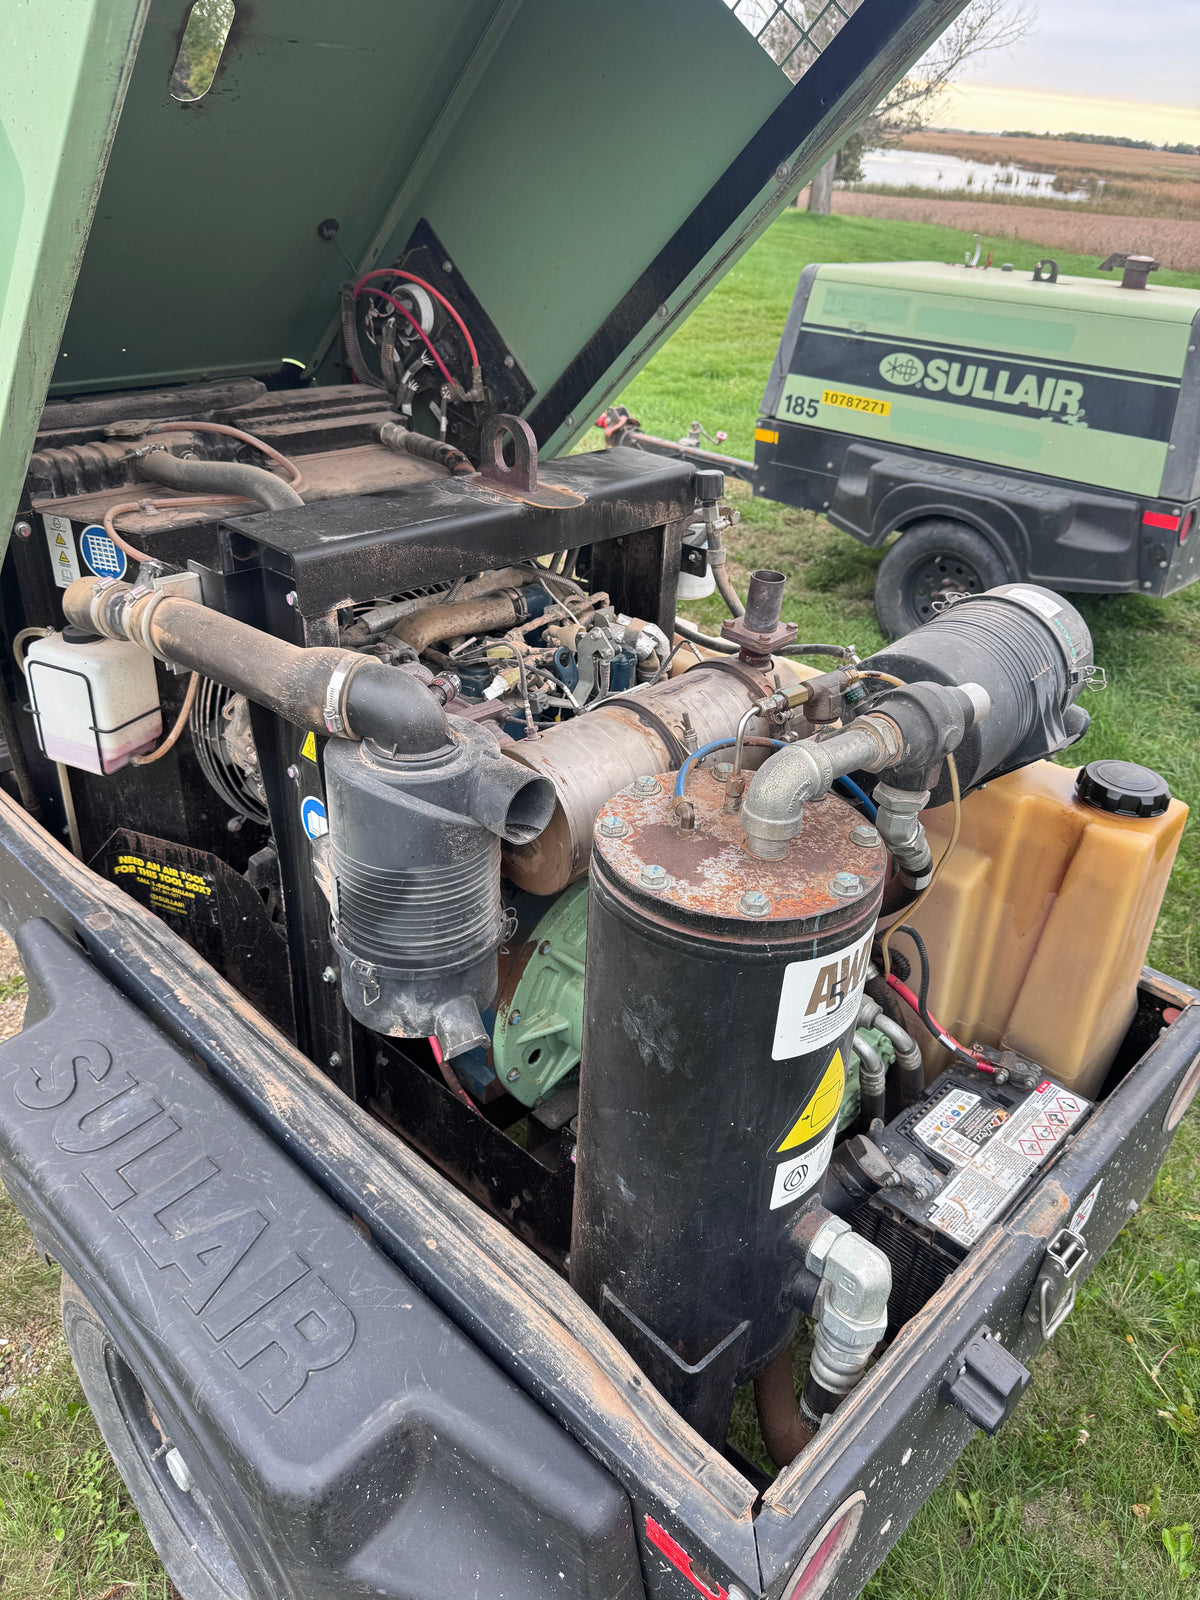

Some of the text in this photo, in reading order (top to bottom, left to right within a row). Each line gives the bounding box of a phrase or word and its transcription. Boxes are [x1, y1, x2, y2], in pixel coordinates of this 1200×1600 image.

[923, 358, 1083, 415] SULLAIR
[785, 393, 820, 418] 185
[823, 392, 885, 414] 10787271
[114, 864, 137, 875] FOR
[137, 866, 158, 880] THIS
[158, 873, 184, 888] TOOL
[184, 881, 212, 896] BOX?
[118, 856, 206, 886] NEED AN AIR TOOL
[136, 876, 150, 886] CALL
[1021, 1161, 1038, 1179] DANGER
[14, 1039, 357, 1414] SULLAIR
